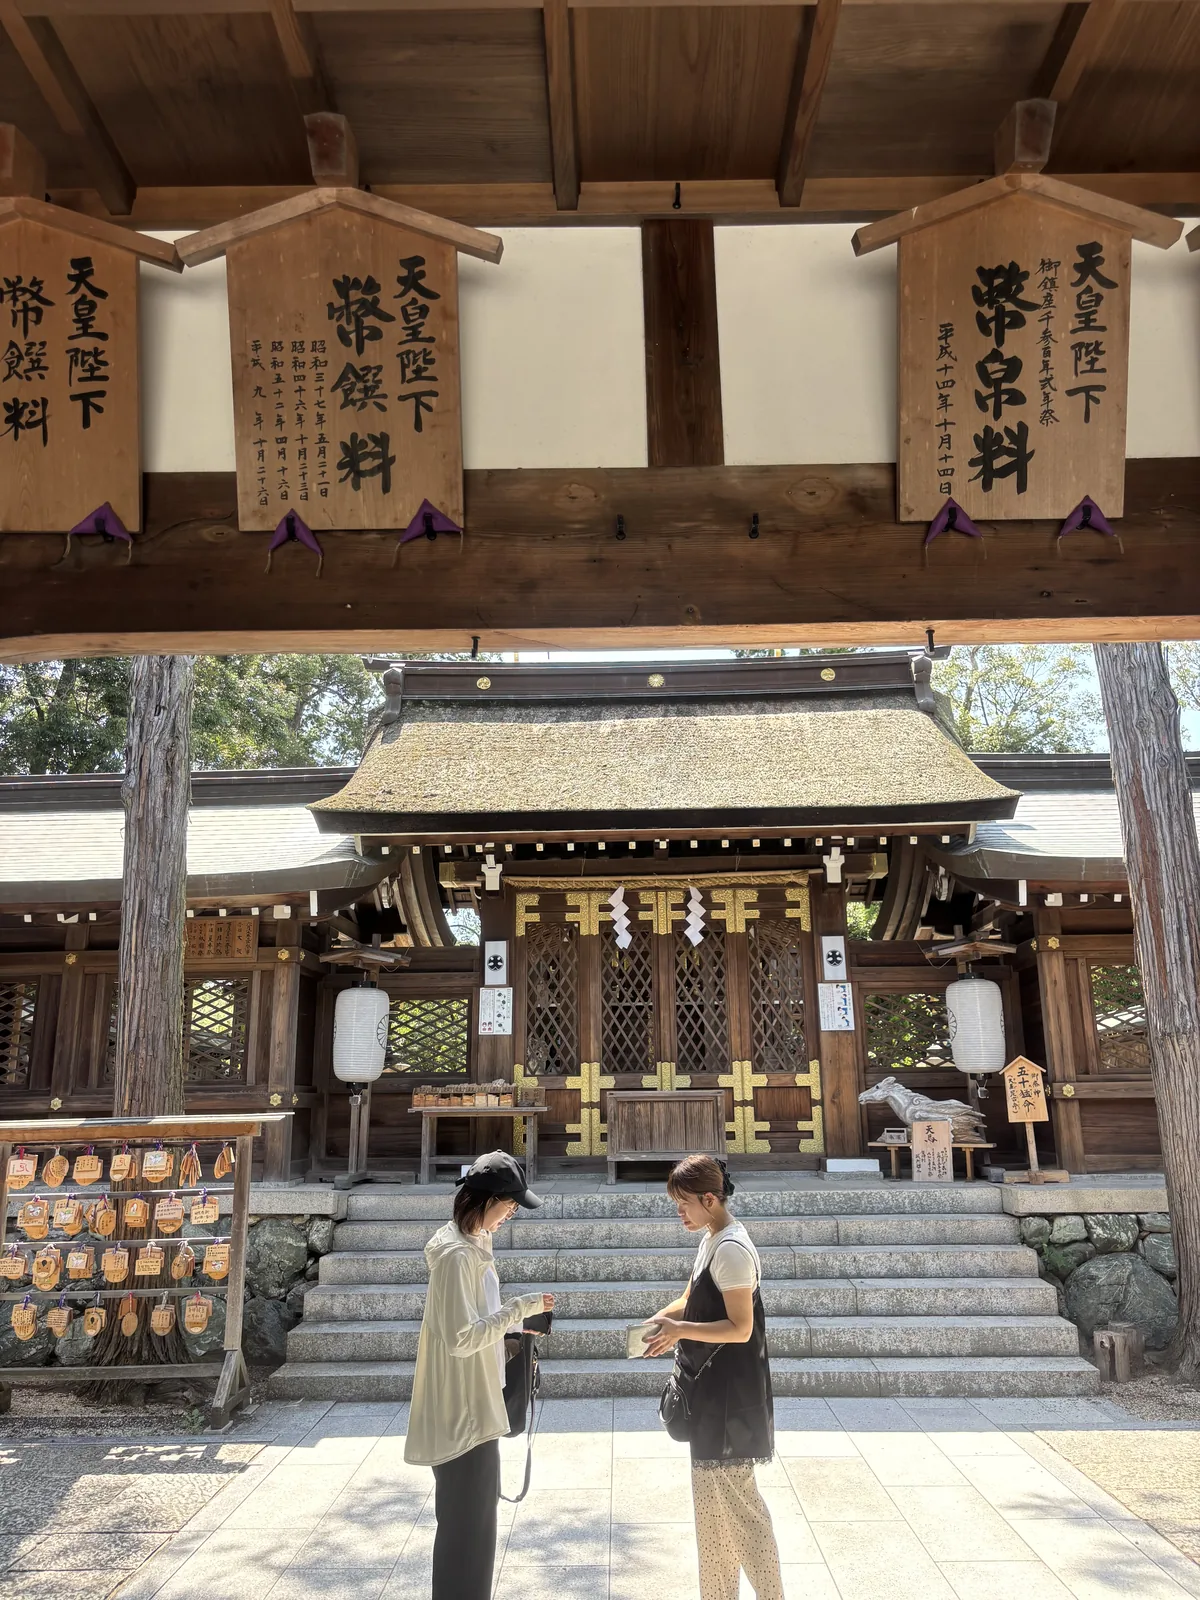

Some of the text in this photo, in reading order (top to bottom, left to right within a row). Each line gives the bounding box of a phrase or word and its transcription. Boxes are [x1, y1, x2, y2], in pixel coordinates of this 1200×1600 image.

[65, 256, 109, 430] 天皇陛下
[309, 340, 330, 498] 昭和三十七年五月二十一日
[327, 273, 396, 495] 幣饌料
[393, 255, 441, 433] 天皇陛下
[935, 322, 957, 496] 平成十四年十月十四日
[967, 260, 1041, 495] 幣帛料
[1065, 241, 1119, 424] 天皇陛下
[270, 341, 290, 501] 昭和五十二年四月十六日
[291, 340, 309, 501] 昭和四十六年十月二十三日
[1017, 1066, 1034, 1113] 五十猛命
